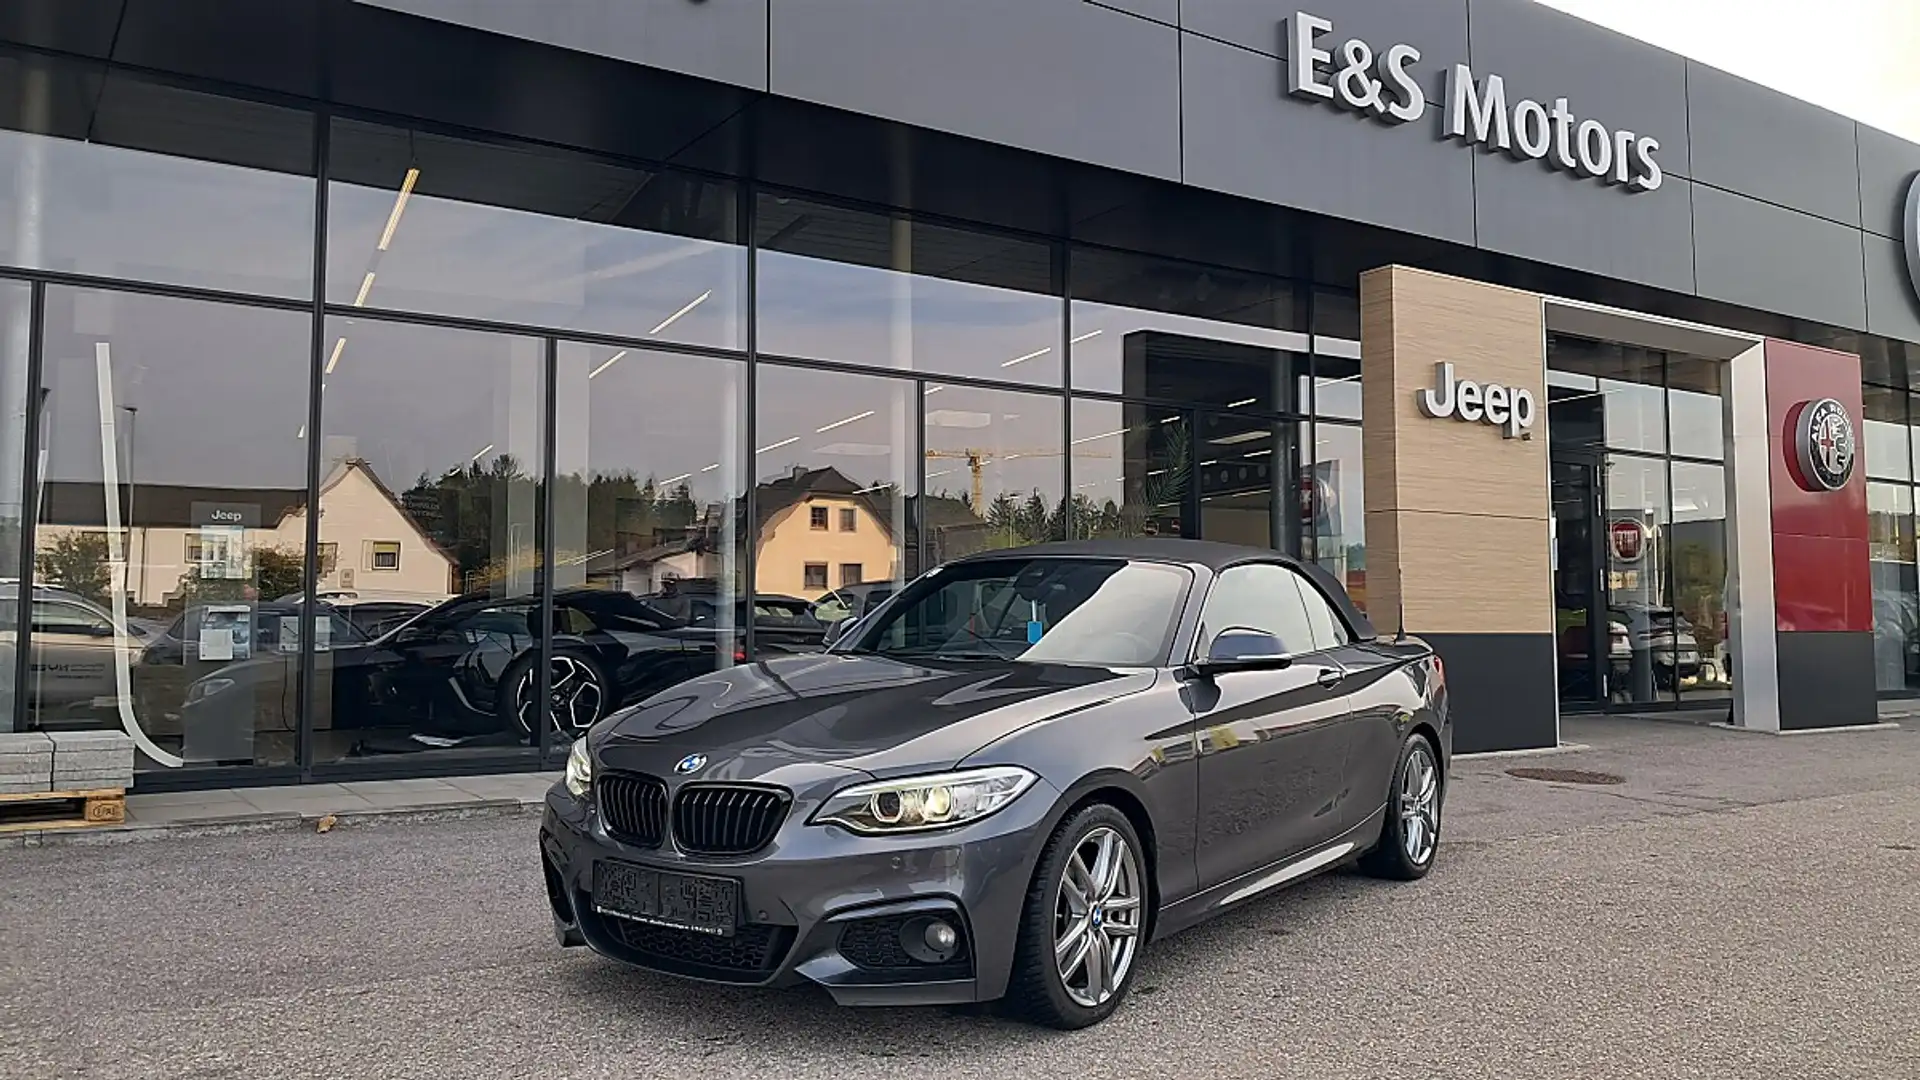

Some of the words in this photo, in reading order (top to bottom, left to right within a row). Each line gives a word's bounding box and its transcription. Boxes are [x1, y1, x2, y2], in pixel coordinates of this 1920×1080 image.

[1286, 11, 1426, 123] E&S
[1443, 63, 1663, 191] Motors
[1416, 361, 1535, 440] Jeep
[1811, 407, 1829, 443] ALFA
[211, 509, 242, 522] Jeep
